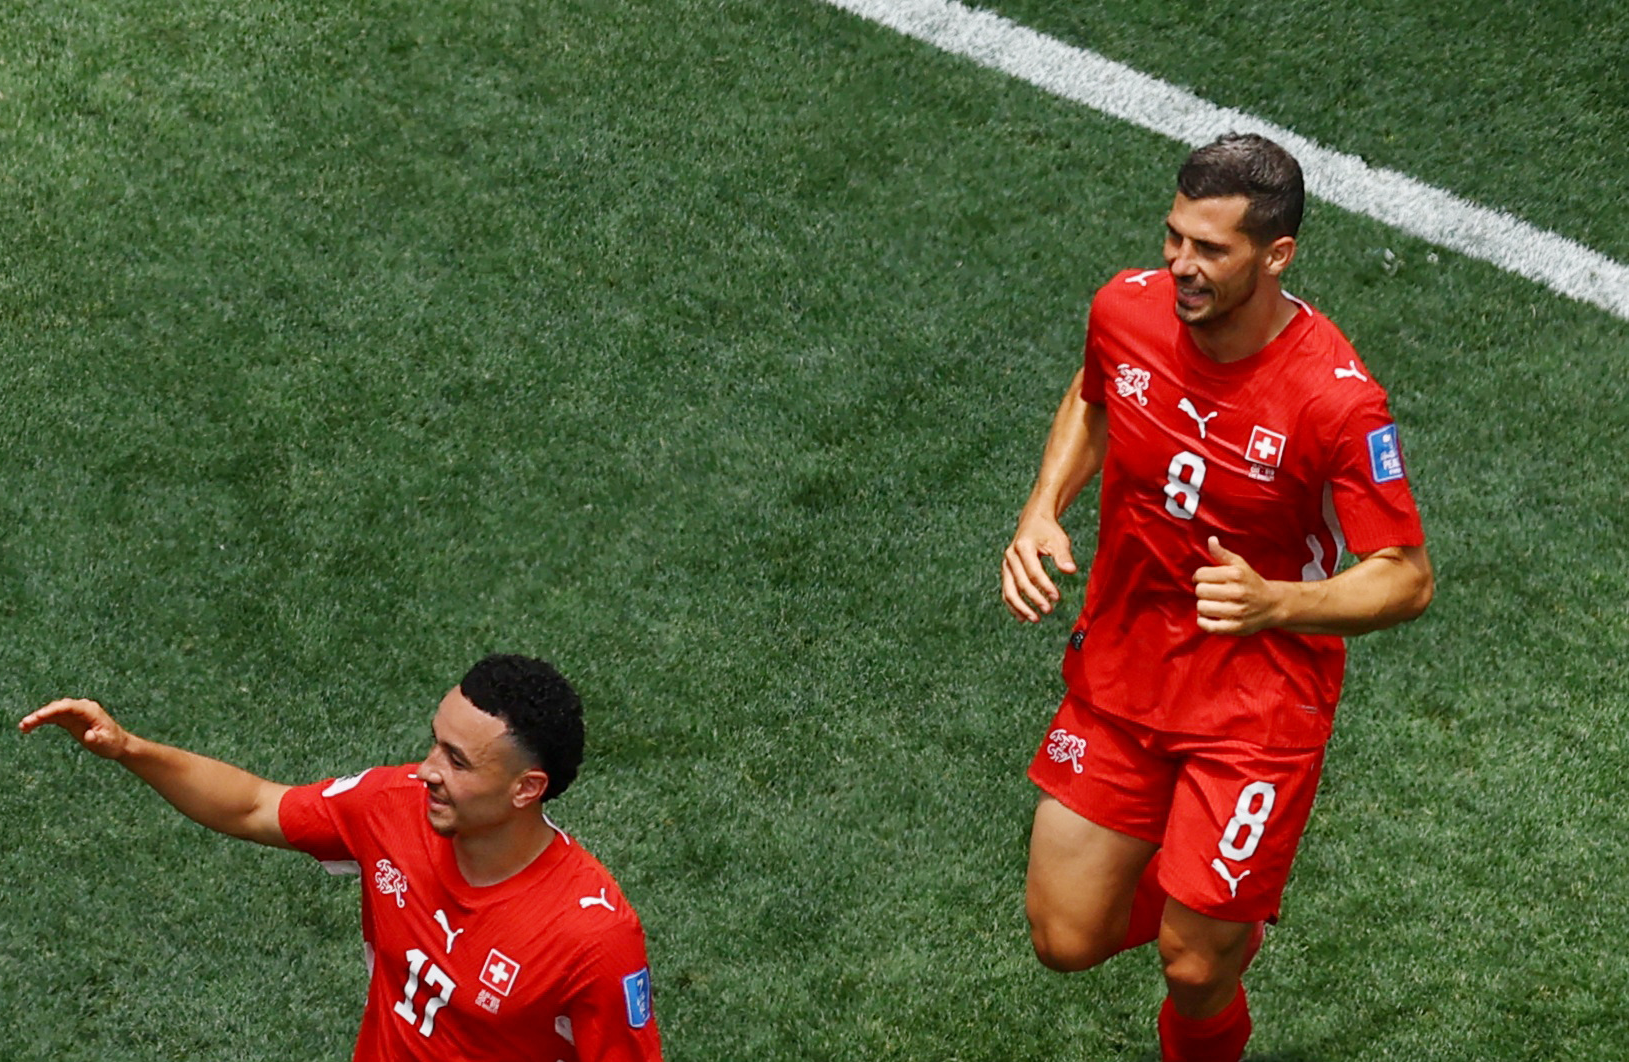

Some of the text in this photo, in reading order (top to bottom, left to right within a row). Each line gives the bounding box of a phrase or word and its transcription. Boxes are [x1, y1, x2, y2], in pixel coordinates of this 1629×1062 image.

[1163, 450, 1207, 520] 8
[1218, 780, 1276, 862] 8
[393, 948, 457, 1038] 17
